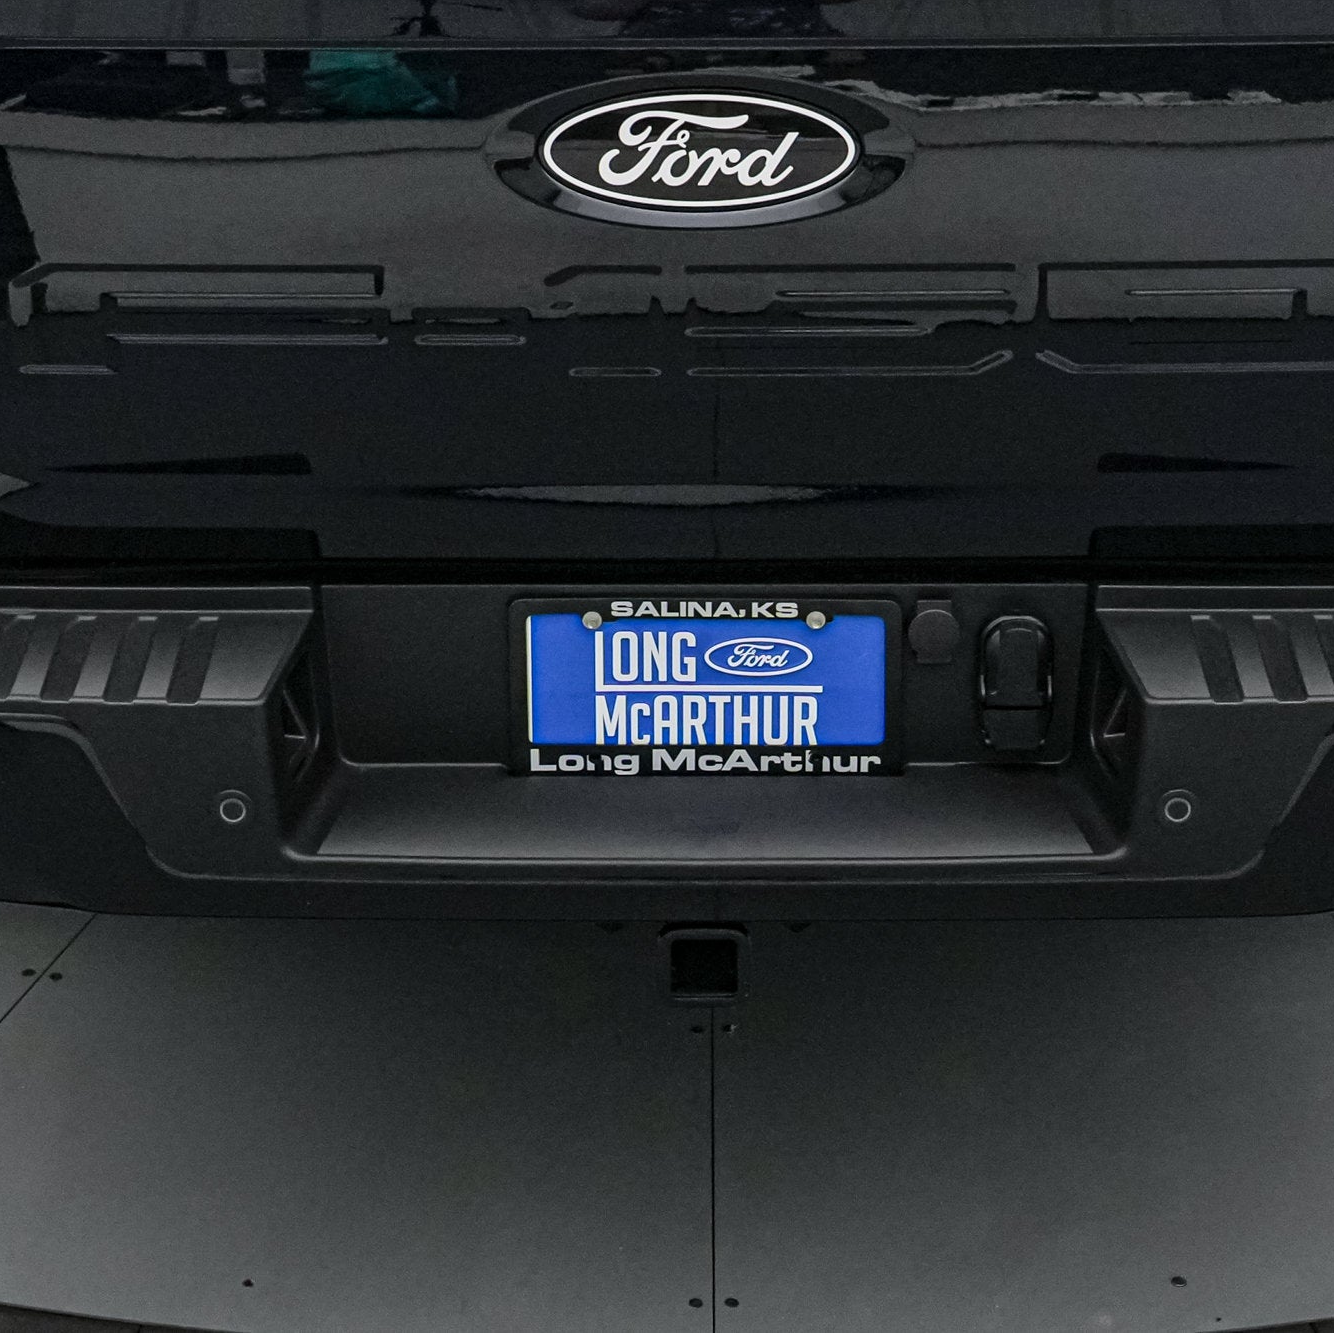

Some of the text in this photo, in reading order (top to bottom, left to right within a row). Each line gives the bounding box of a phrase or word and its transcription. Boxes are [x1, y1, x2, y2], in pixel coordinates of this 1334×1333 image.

[599, 111, 799, 186] Ford
[596, 631, 696, 692] LONG
[727, 644, 788, 668] Ford
[596, 695, 818, 745] McARTHUR
[530, 749, 882, 776] Long McArthur
